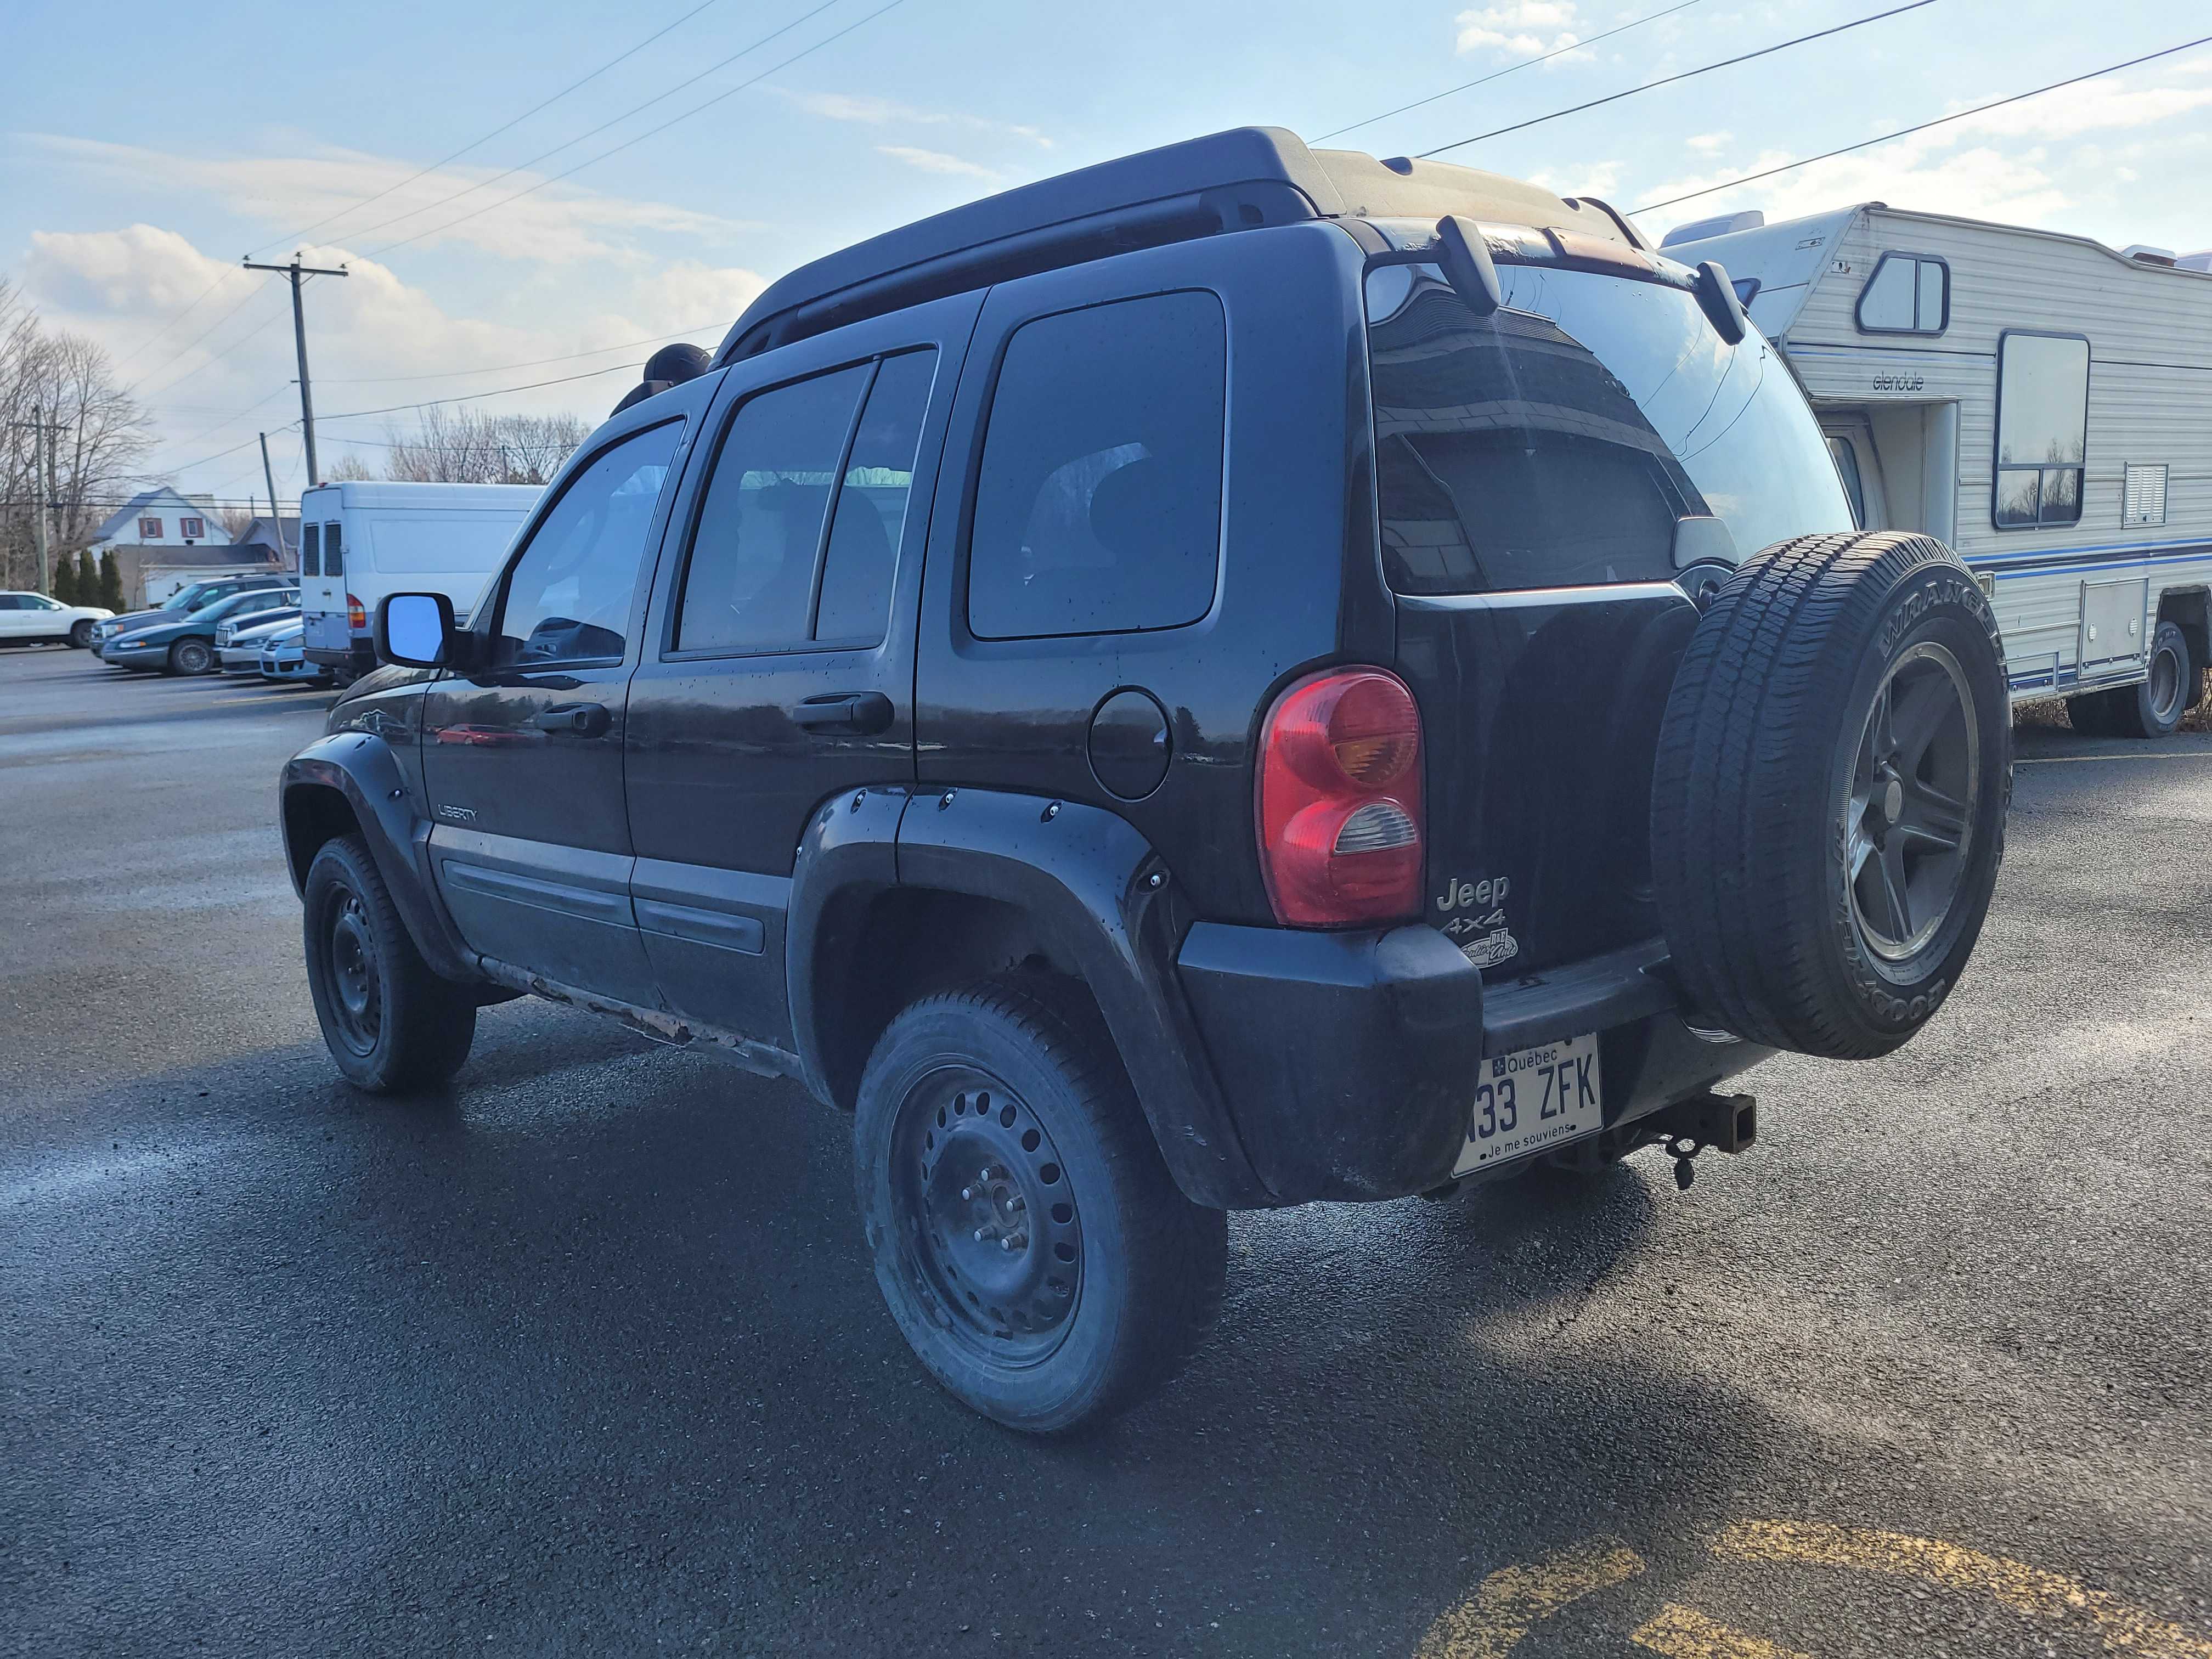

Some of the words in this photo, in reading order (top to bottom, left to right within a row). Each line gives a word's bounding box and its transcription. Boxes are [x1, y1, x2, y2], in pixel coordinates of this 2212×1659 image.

[438, 804, 477, 821] LIBERTY
[1436, 877, 1510, 911] Jeep
[1508, 1049, 1558, 1073] Québec
[1538, 1053, 1595, 1120] ZFK
[1488, 1145, 1500, 1158] Je
[1505, 1140, 1520, 1153] me
[1523, 1124, 1570, 1146] souviens
